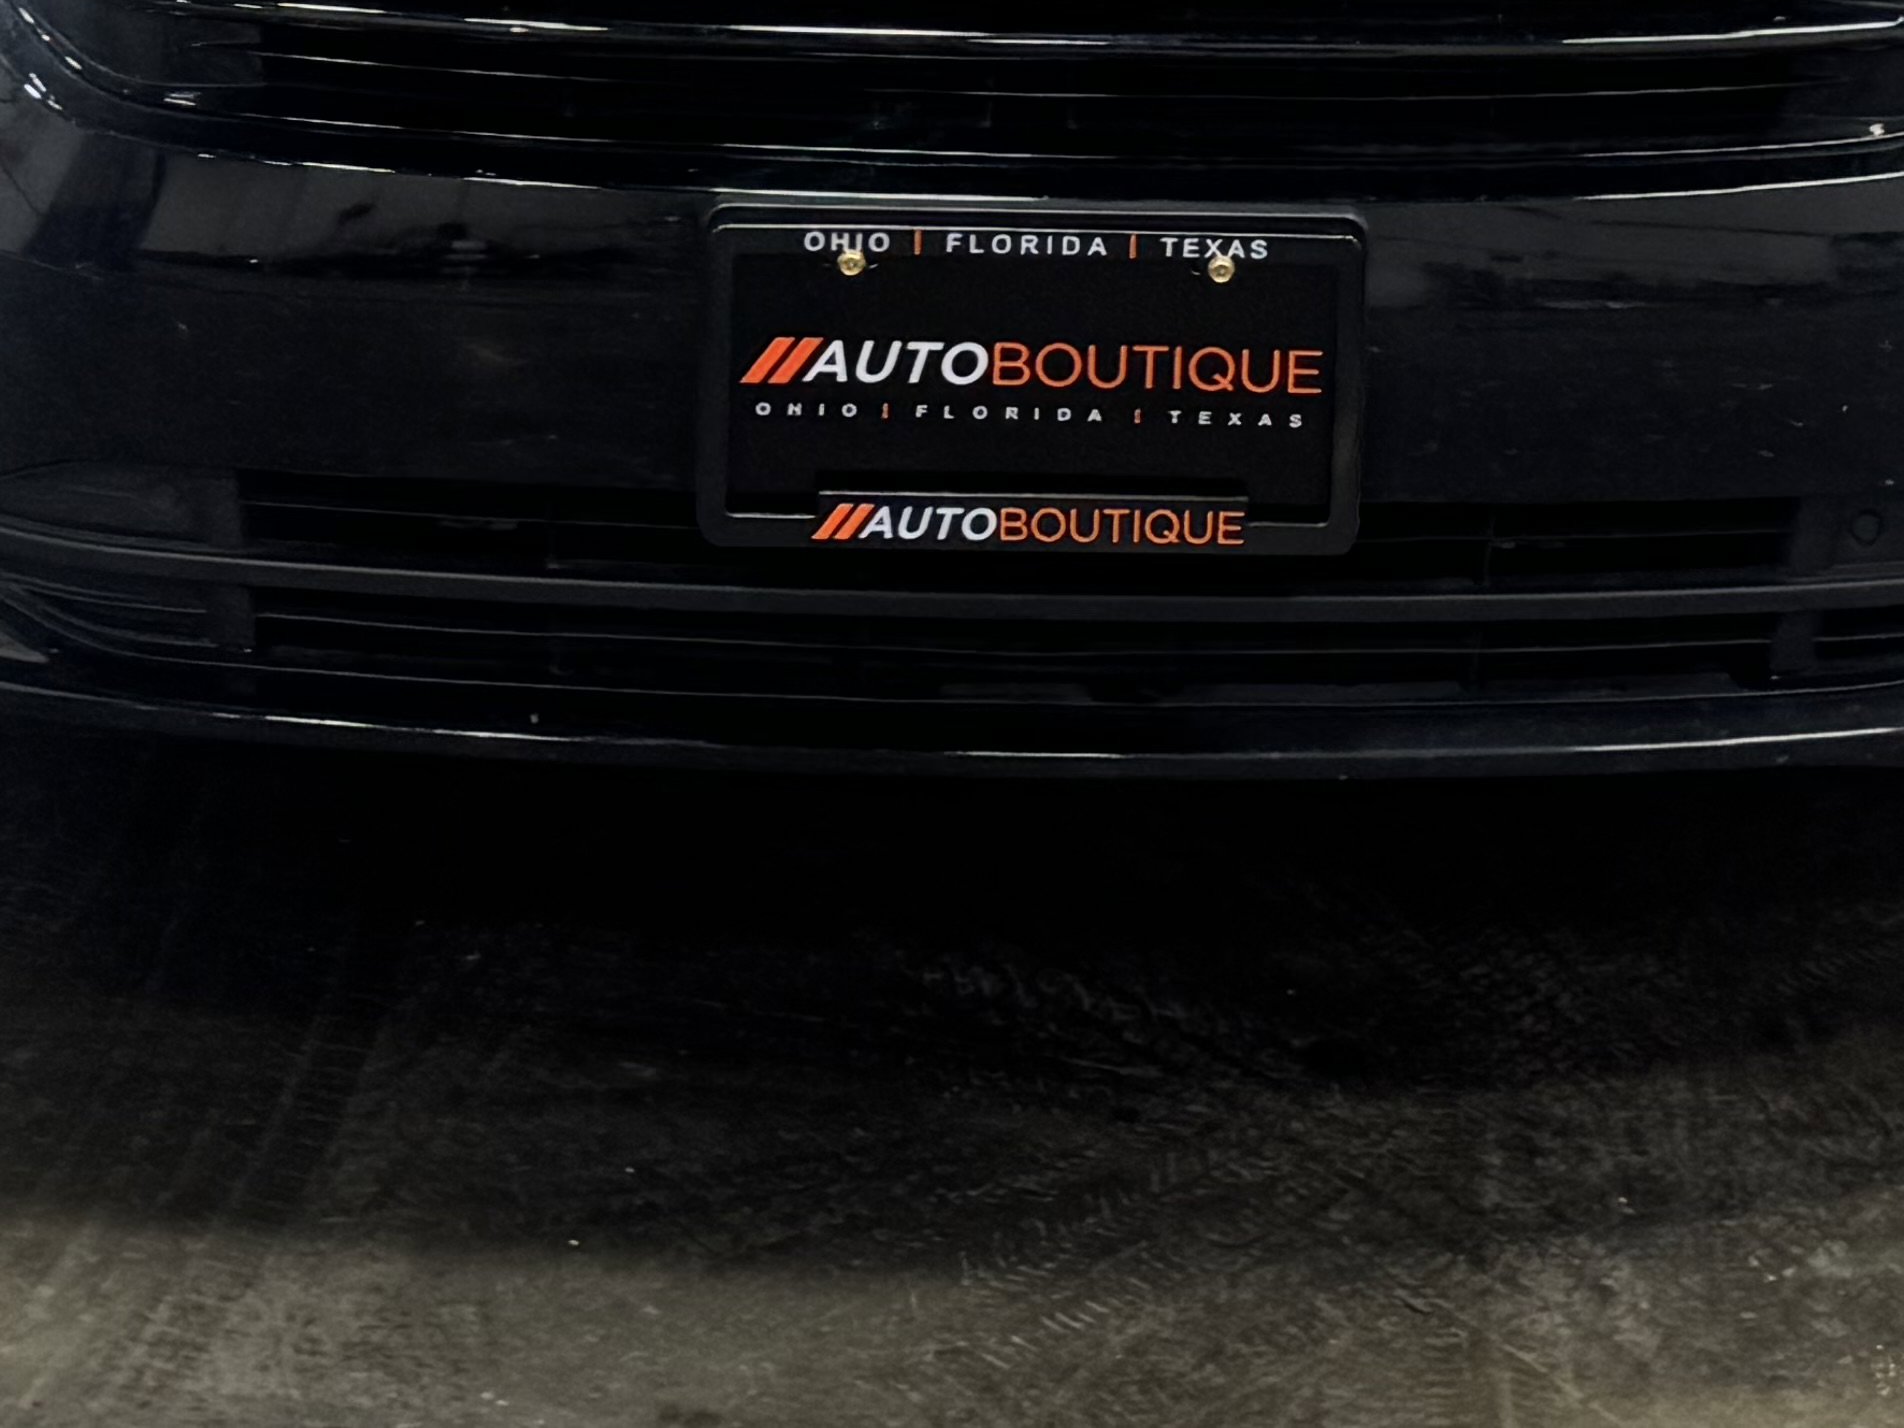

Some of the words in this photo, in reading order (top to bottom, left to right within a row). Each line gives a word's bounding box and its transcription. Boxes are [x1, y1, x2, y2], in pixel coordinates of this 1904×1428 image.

[803, 229, 891, 254] OHIO
[945, 231, 1108, 257] FLORIDA
[1160, 236, 1269, 260] TEXAS
[802, 339, 1324, 395] AUTOBOUTIQUE
[754, 400, 859, 419] OHIO
[914, 404, 1104, 423] FLORIDA
[1169, 409, 1304, 430] TEXAS
[858, 505, 1246, 546] AUTOBOUTIQUE
